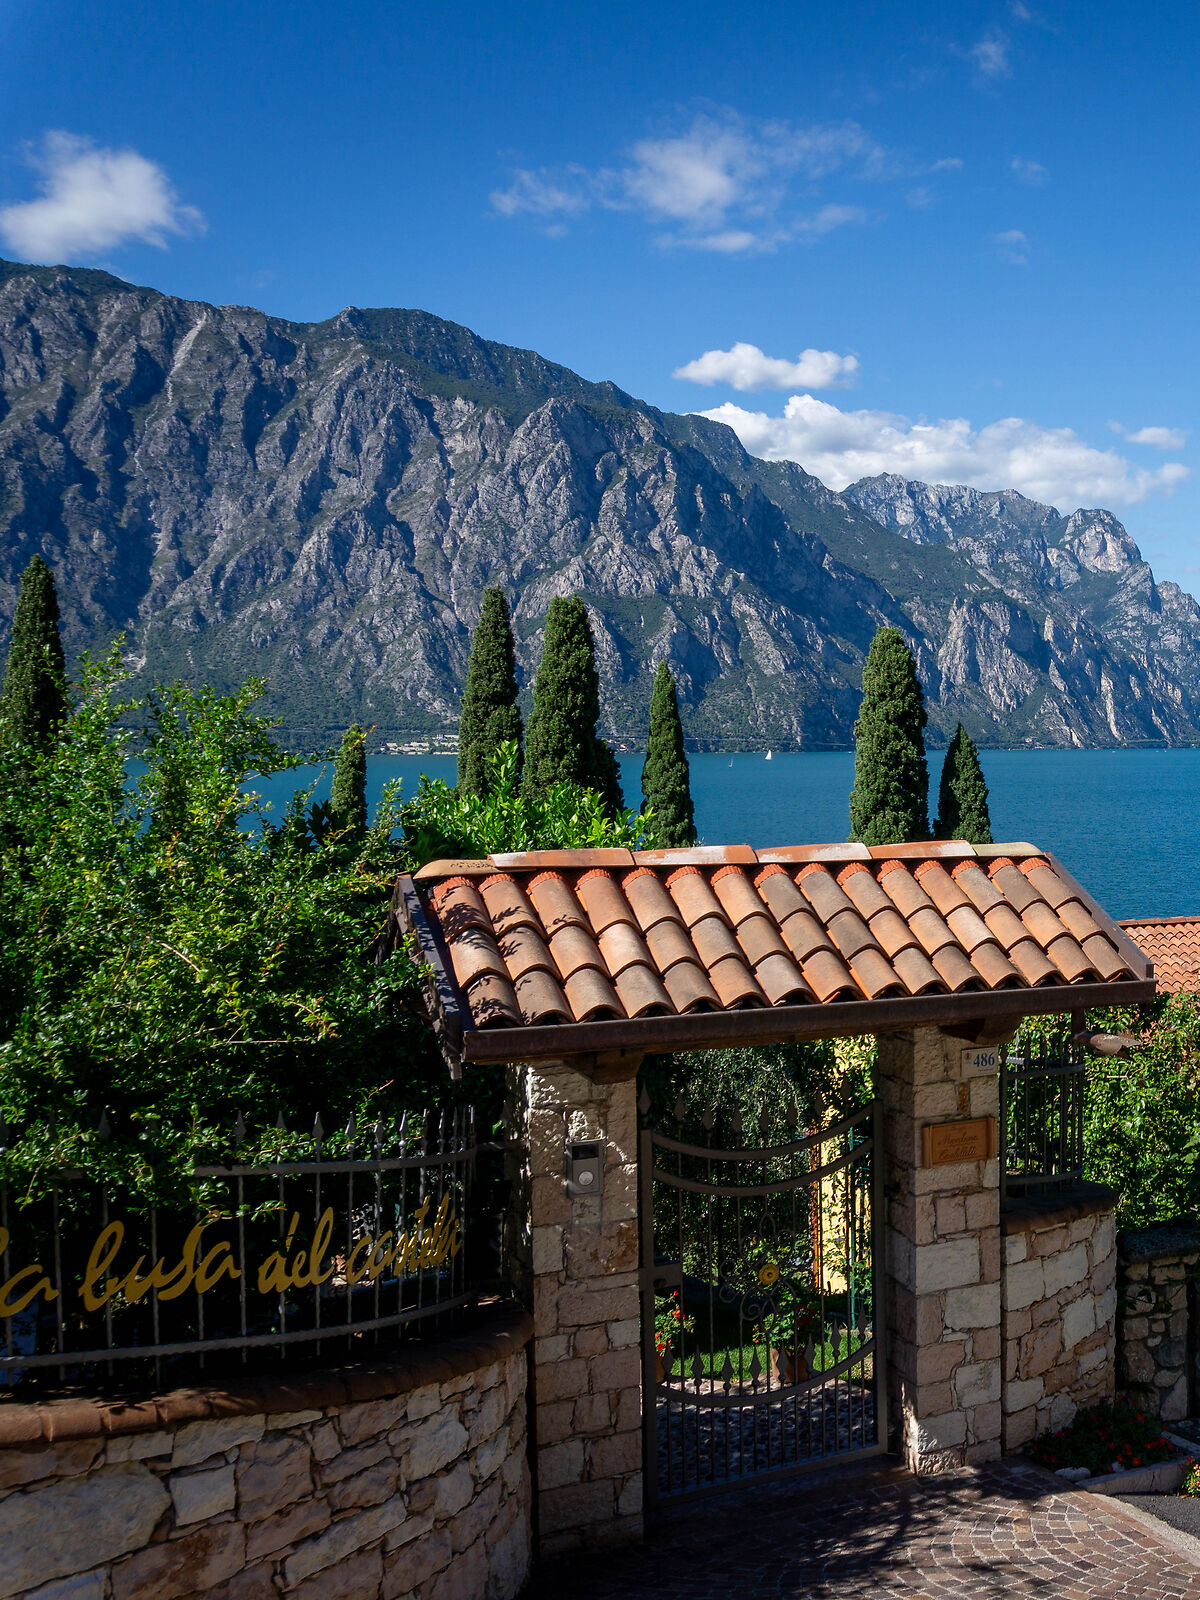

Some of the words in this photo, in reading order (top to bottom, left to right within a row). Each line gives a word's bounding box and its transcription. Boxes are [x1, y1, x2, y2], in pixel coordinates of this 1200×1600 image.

[973, 1052, 996, 1068] 486
[0, 1226, 60, 1318] a
[78, 1210, 242, 1312] busa
